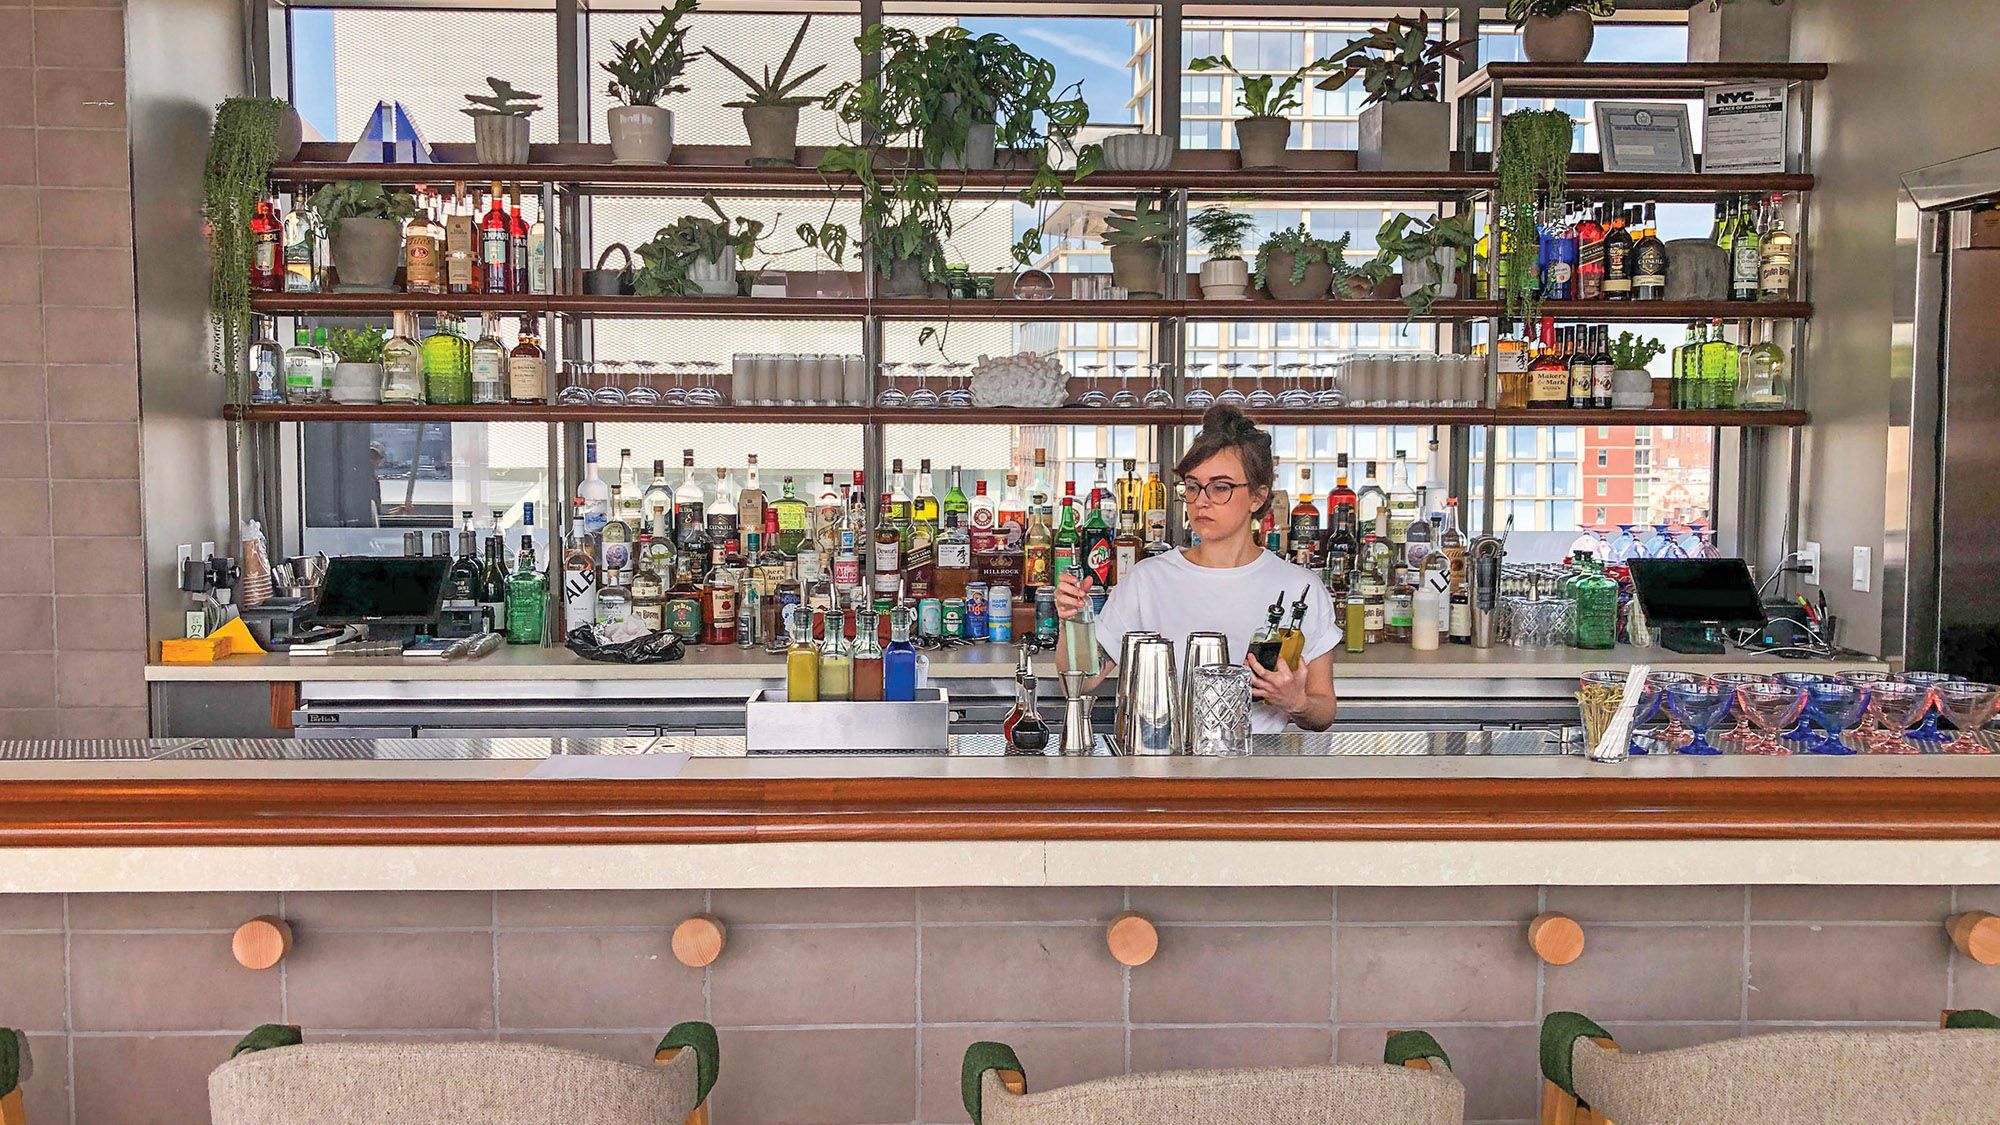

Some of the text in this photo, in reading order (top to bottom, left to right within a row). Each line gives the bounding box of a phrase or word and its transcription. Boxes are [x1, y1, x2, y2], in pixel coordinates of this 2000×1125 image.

[1716, 91, 1754, 104] NYC
[565, 569, 596, 604] ALB
[968, 604, 987, 616] Tiger
[191, 624, 202, 633] 97
